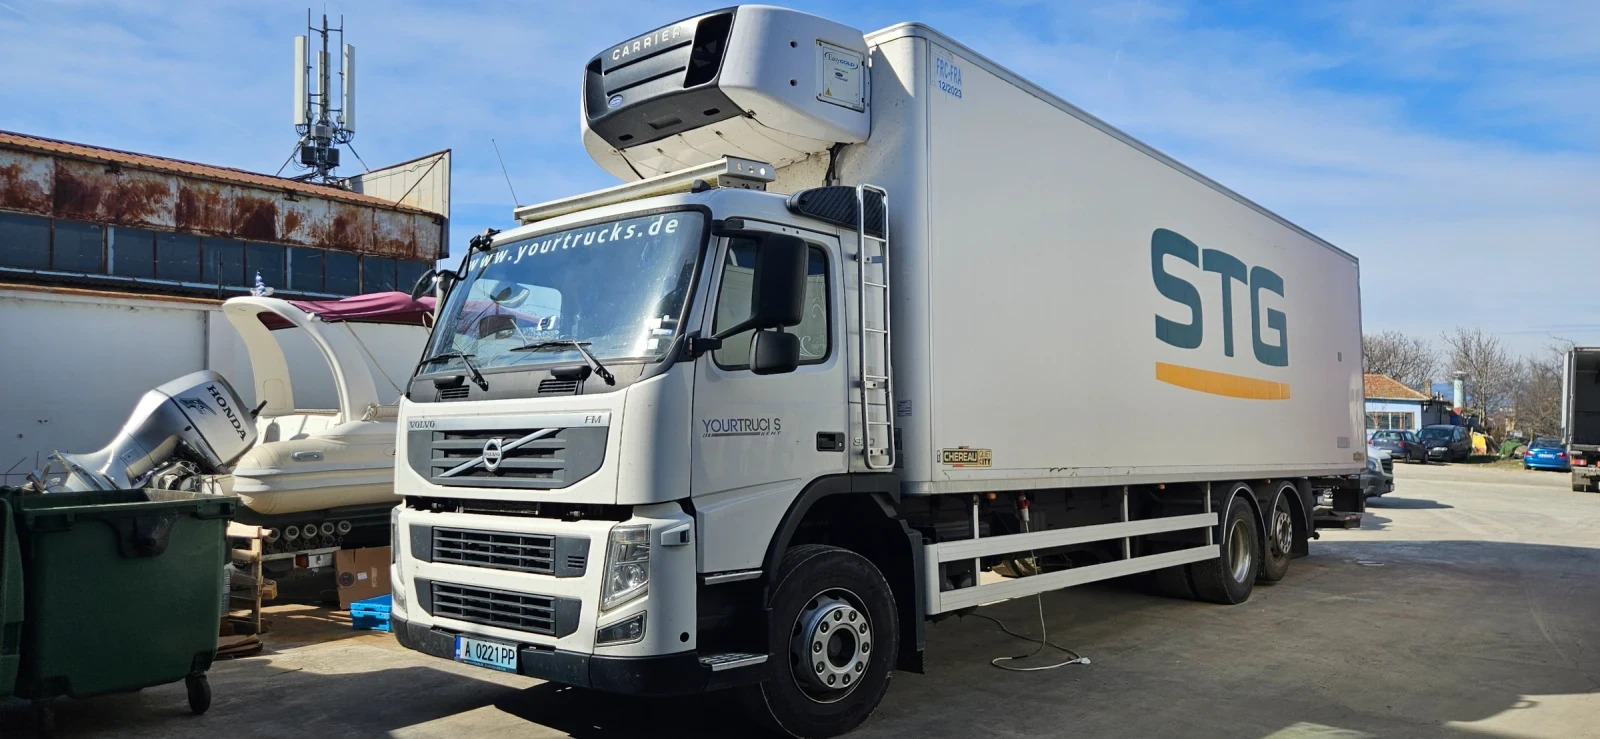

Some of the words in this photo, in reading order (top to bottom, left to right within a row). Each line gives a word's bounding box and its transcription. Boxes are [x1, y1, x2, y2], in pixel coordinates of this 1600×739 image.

[612, 26, 682, 60] CARRIER
[936, 57, 962, 85] FRC-FRA
[938, 79, 962, 98] 12/2023
[468, 215, 680, 272] www.yourtrucks.de
[1151, 228, 1289, 367] STG
[206, 384, 247, 441] HONDA
[584, 415, 602, 424] FM
[409, 420, 436, 429] VOLVO
[944, 451, 977, 462] CHEREAU
[464, 641, 471, 657] A
